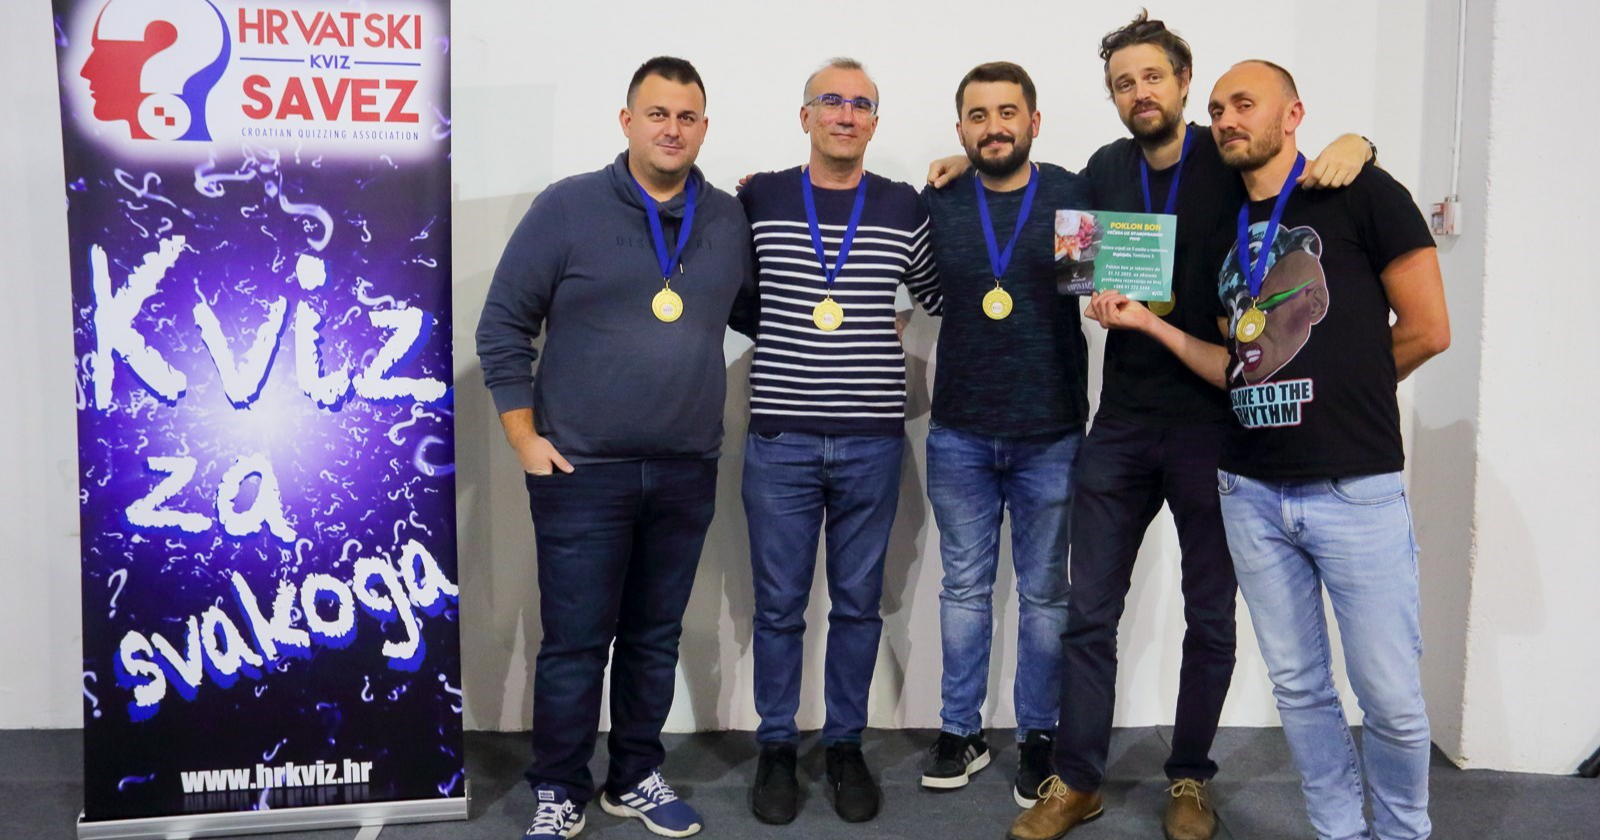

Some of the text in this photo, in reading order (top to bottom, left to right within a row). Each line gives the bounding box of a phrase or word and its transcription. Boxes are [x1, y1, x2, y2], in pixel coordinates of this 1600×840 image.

[238, 7, 422, 50] HRVATSKI
[310, 54, 351, 70] KVIZ
[241, 74, 420, 123] SAVEZ
[241, 127, 419, 141] CROATIAN QUIZZING ASSOCIATION
[1110, 222, 1143, 231] POKLON
[91, 235, 447, 411] Kviz
[1256, 385, 1276, 403] TO
[1278, 381, 1311, 401] THE
[125, 453, 297, 542] za
[120, 539, 459, 707] svakoga
[180, 758, 373, 793] www.hrkviz.hr
